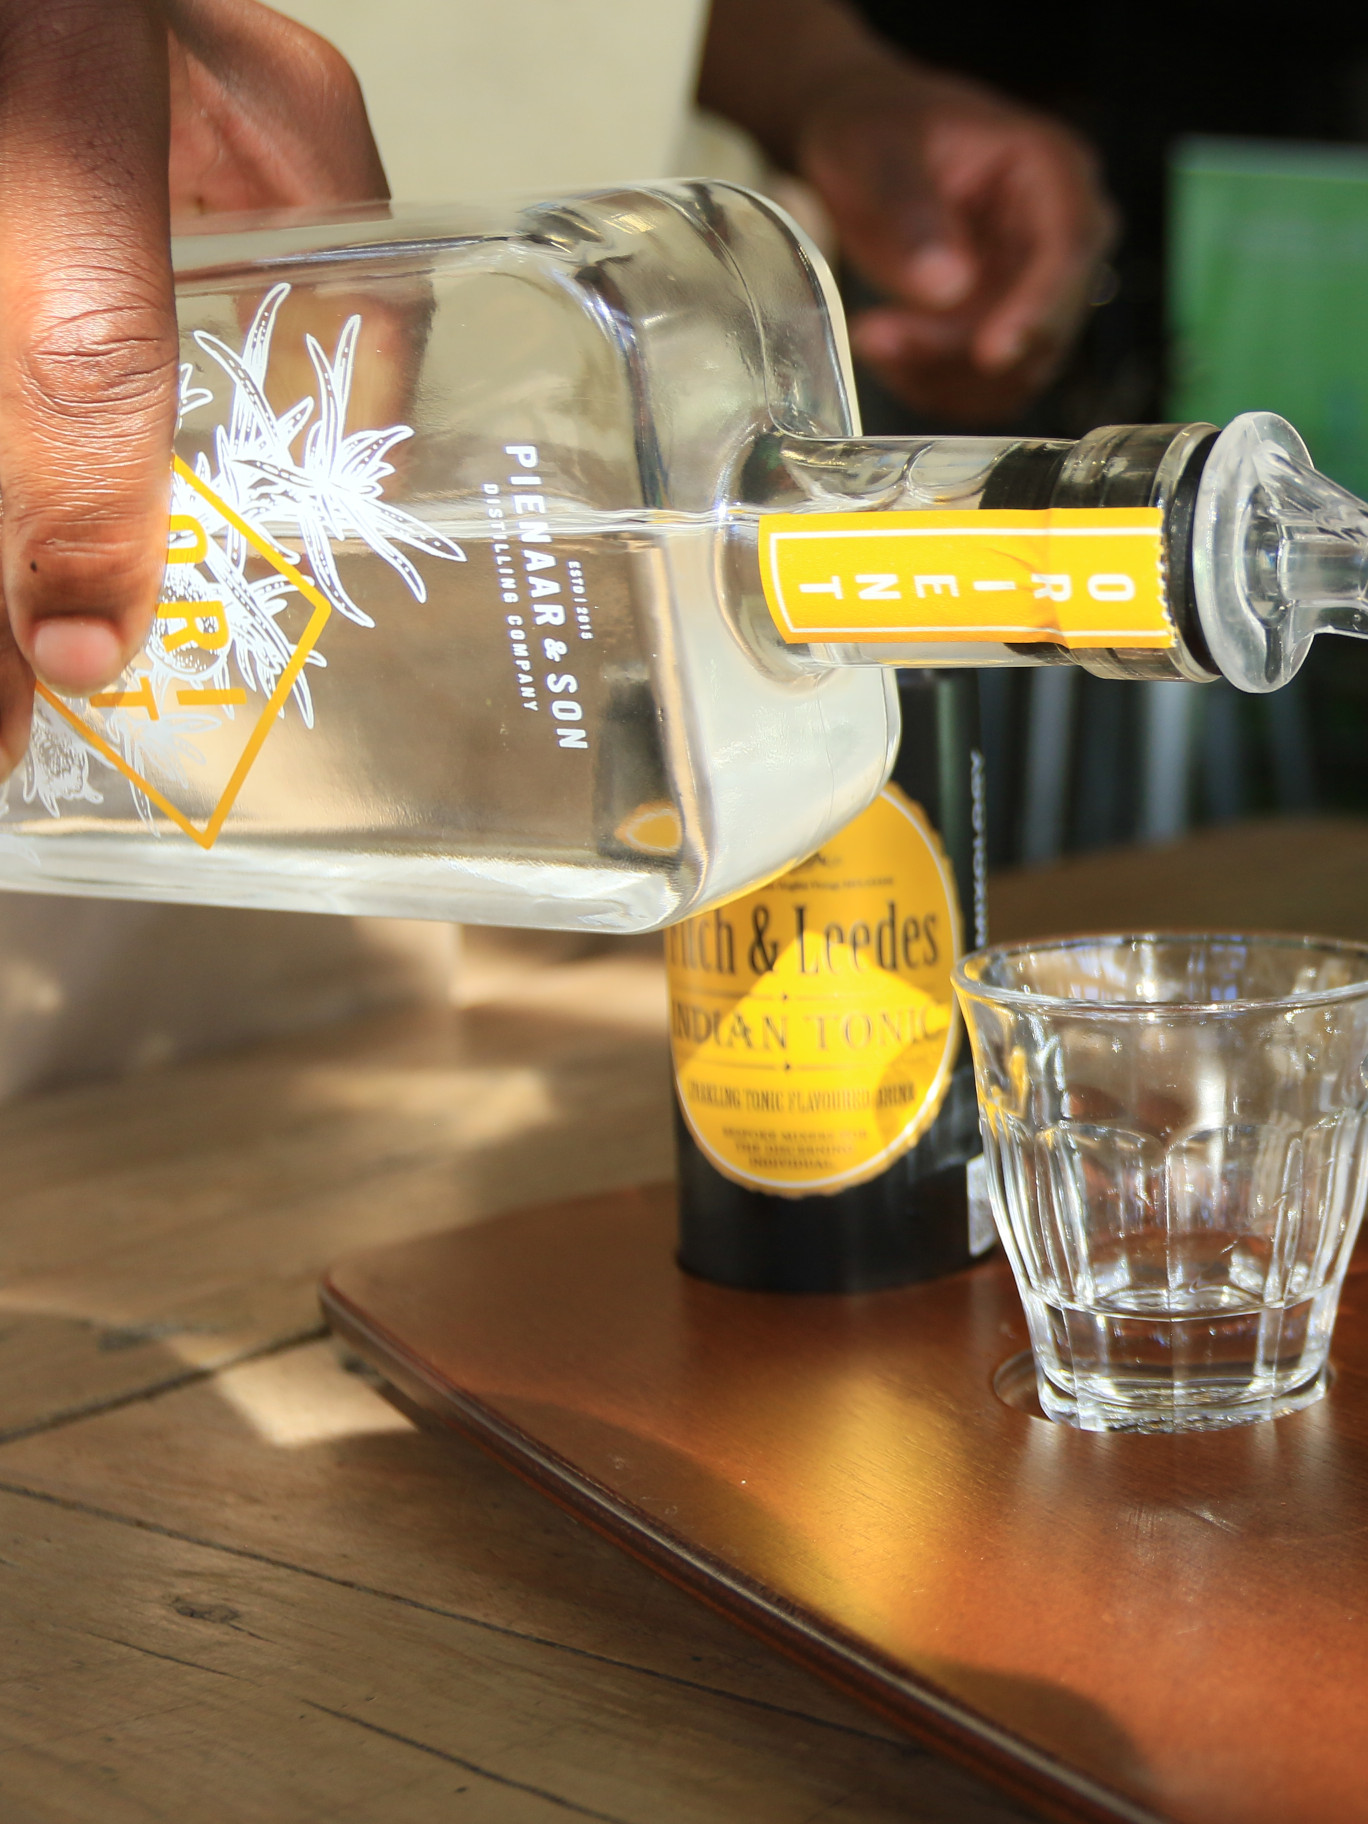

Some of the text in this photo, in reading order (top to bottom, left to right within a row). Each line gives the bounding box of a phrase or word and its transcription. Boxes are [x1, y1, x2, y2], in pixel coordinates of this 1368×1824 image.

[482, 482, 539, 711] DISTILLING COMPANY
[504, 444, 589, 749] PIENAAR & SON
[567, 560, 586, 594] ESTD
[799, 572, 1136, 602] ORIENT
[575, 606, 594, 640] 2015
[747, 903, 779, 976] &
[794, 899, 940, 975] Leedes
[802, 1003, 946, 1051] TONIC
